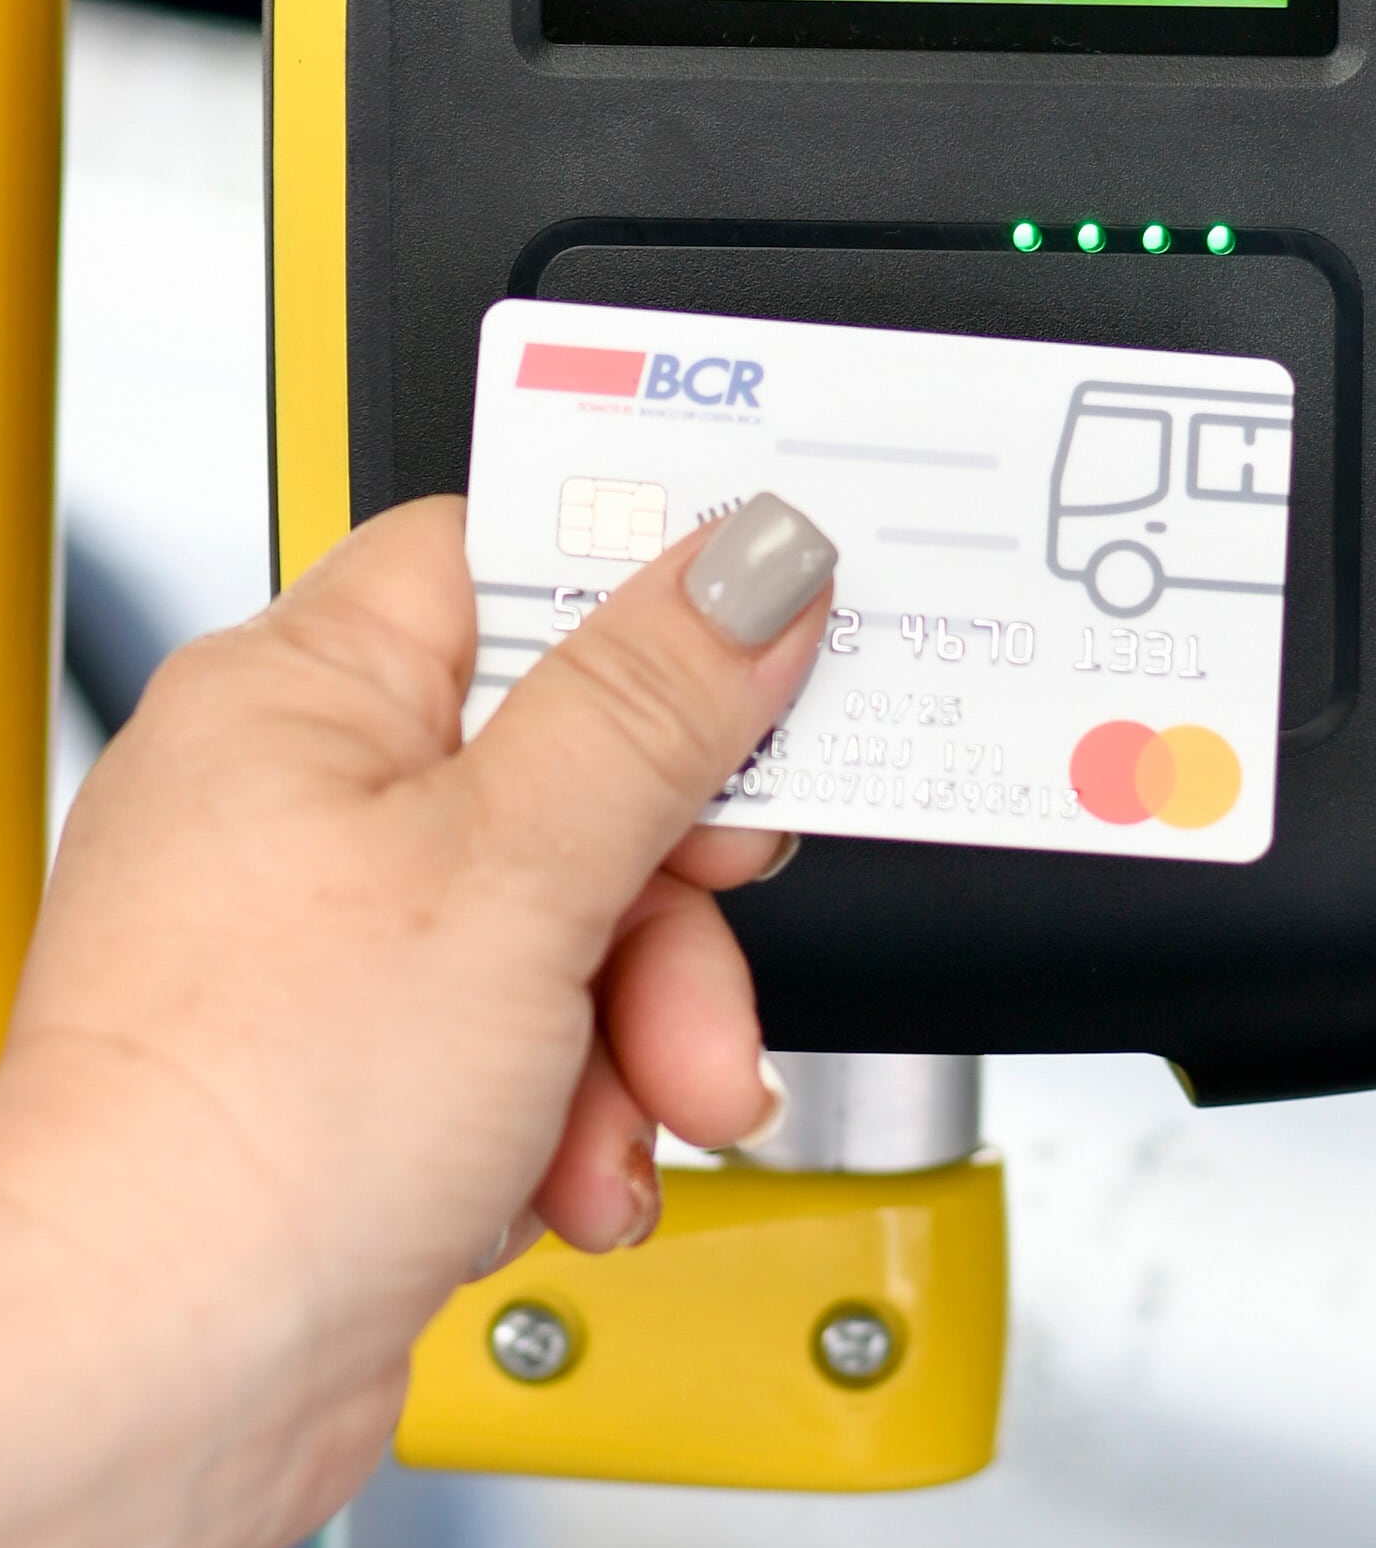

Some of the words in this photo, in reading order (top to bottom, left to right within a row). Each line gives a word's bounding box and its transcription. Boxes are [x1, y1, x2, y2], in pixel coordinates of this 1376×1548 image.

[644, 353, 765, 408] BCR
[901, 614, 1036, 666] 4670
[1073, 626, 1208, 679] 1331
[843, 689, 963, 727] 09/25
[818, 732, 913, 770] TARJ
